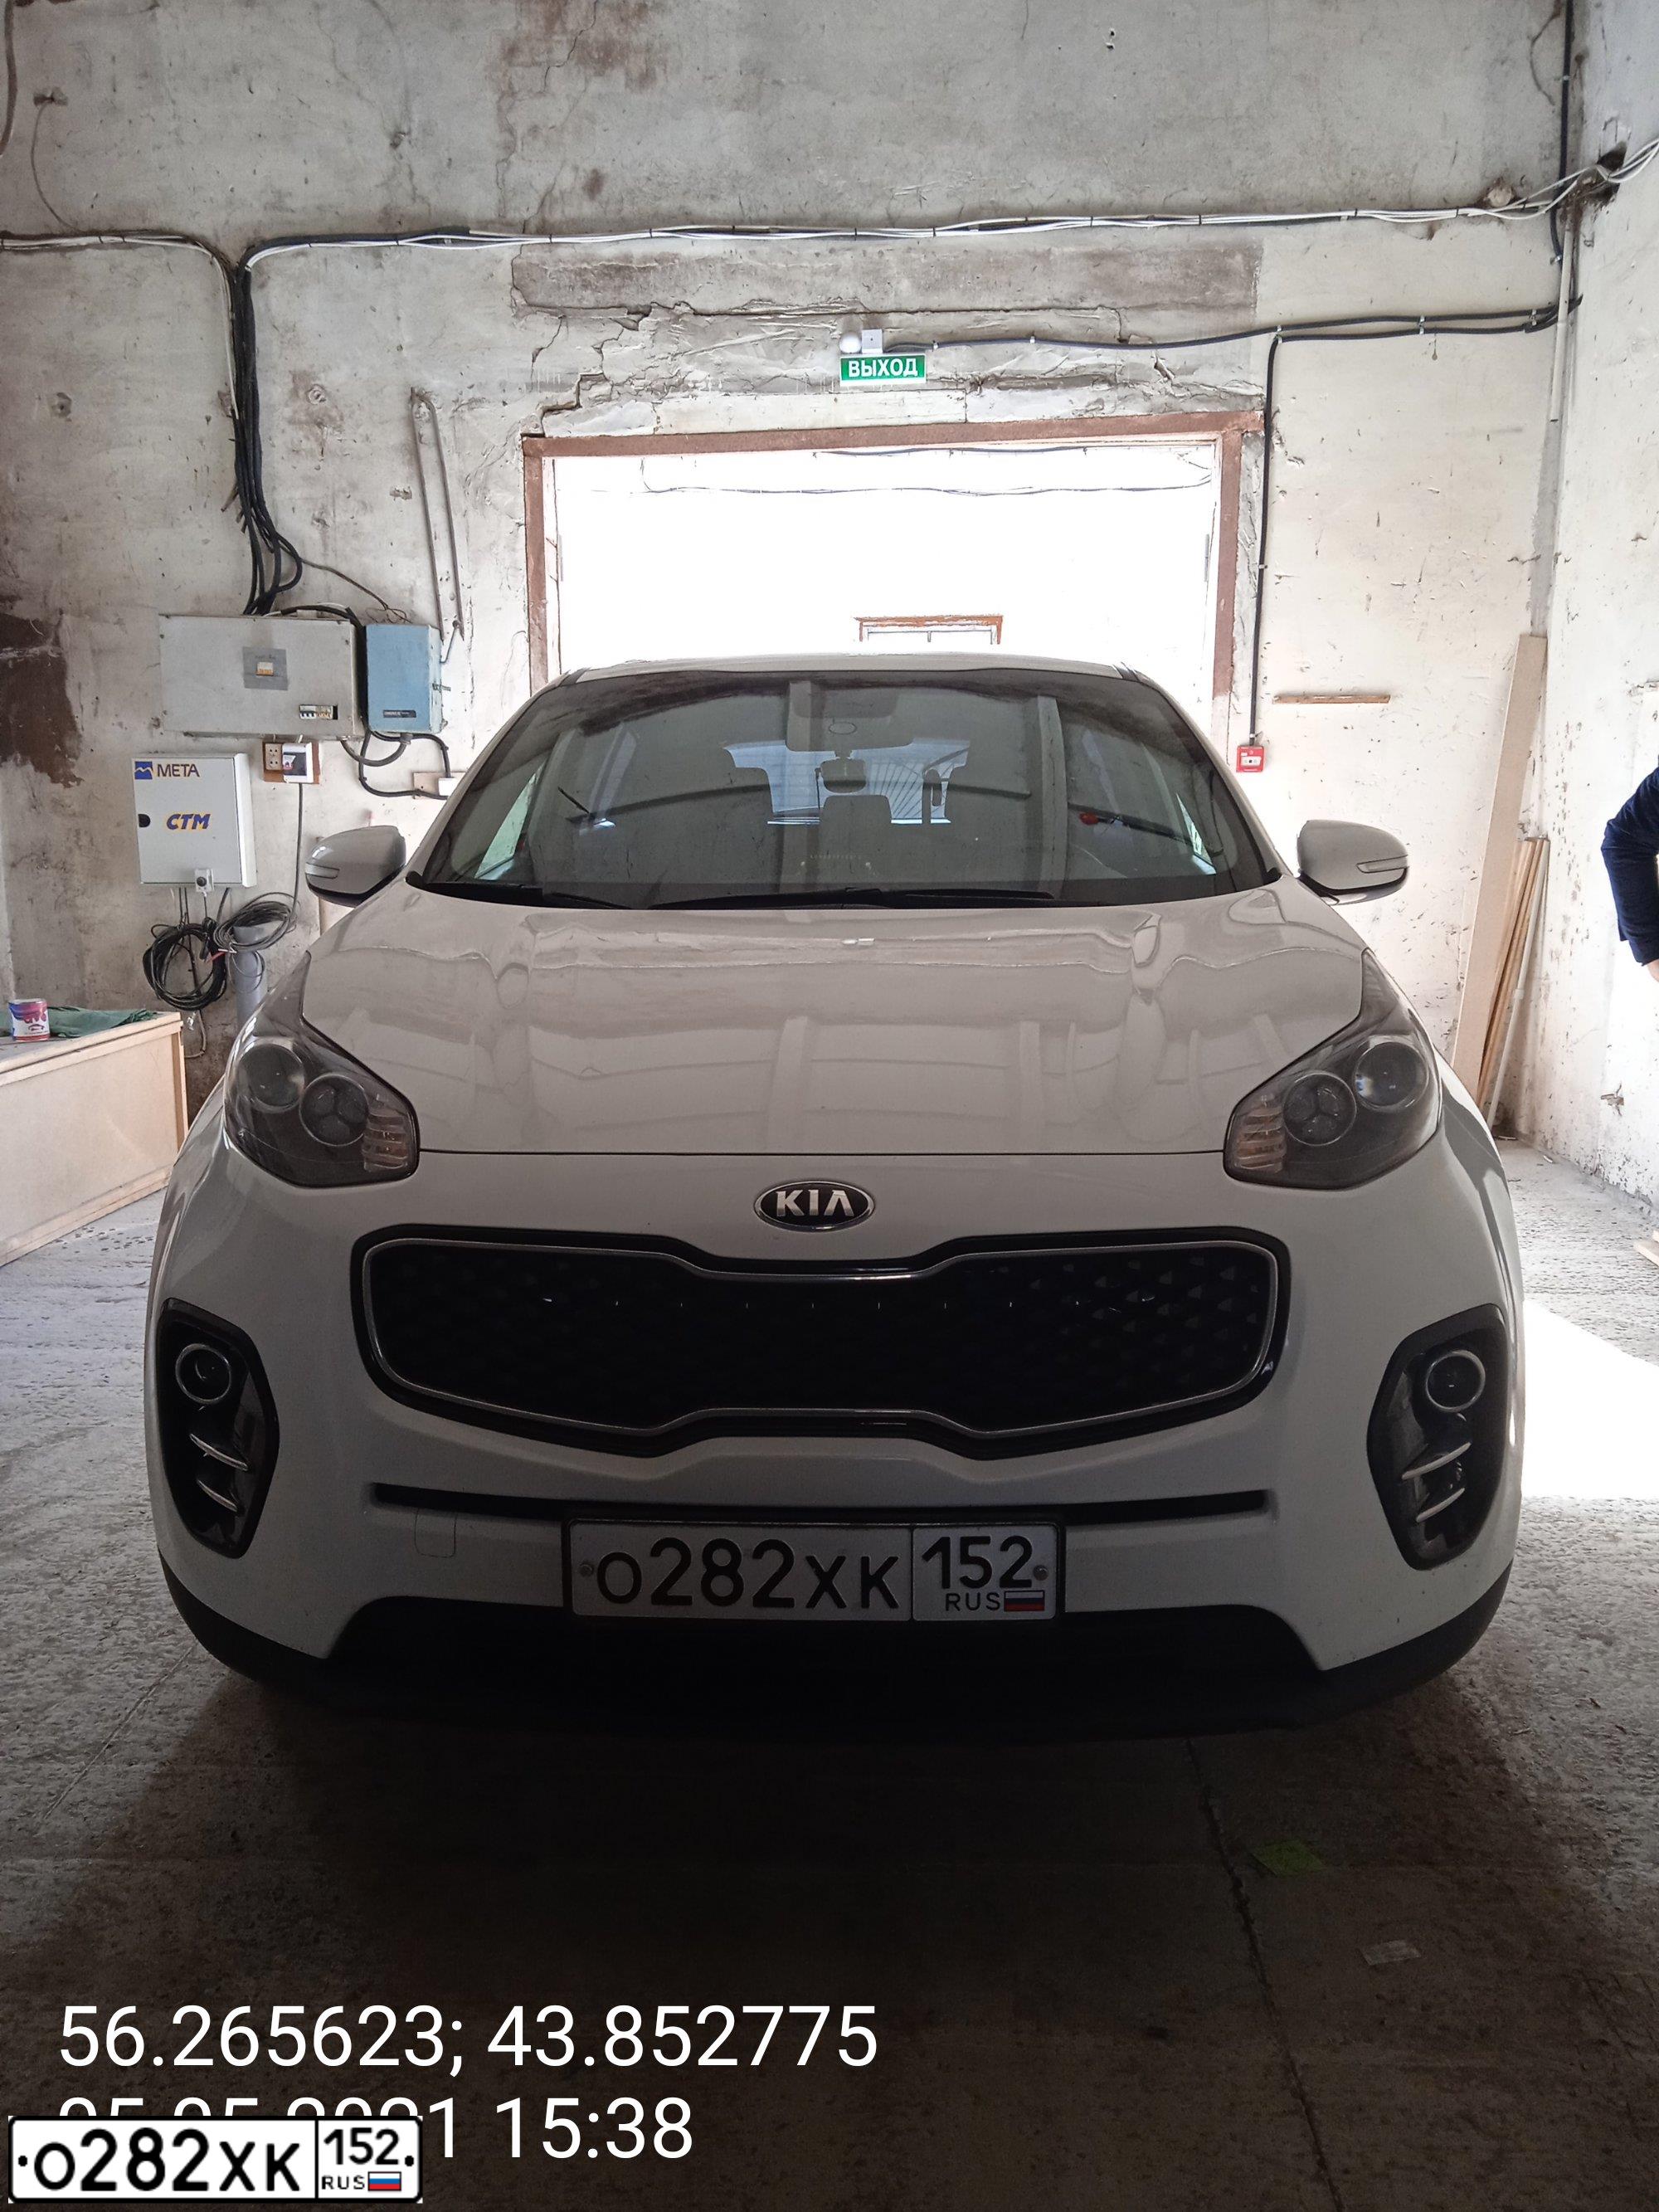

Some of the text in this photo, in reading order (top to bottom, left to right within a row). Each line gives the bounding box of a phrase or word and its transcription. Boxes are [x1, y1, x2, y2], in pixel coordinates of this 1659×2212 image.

[848, 358, 918, 378] ВЫХОД
[776, 1189, 854, 1217] KIA
[922, 1535, 1033, 1589] 152
[945, 1591, 1000, 1611] RUS
